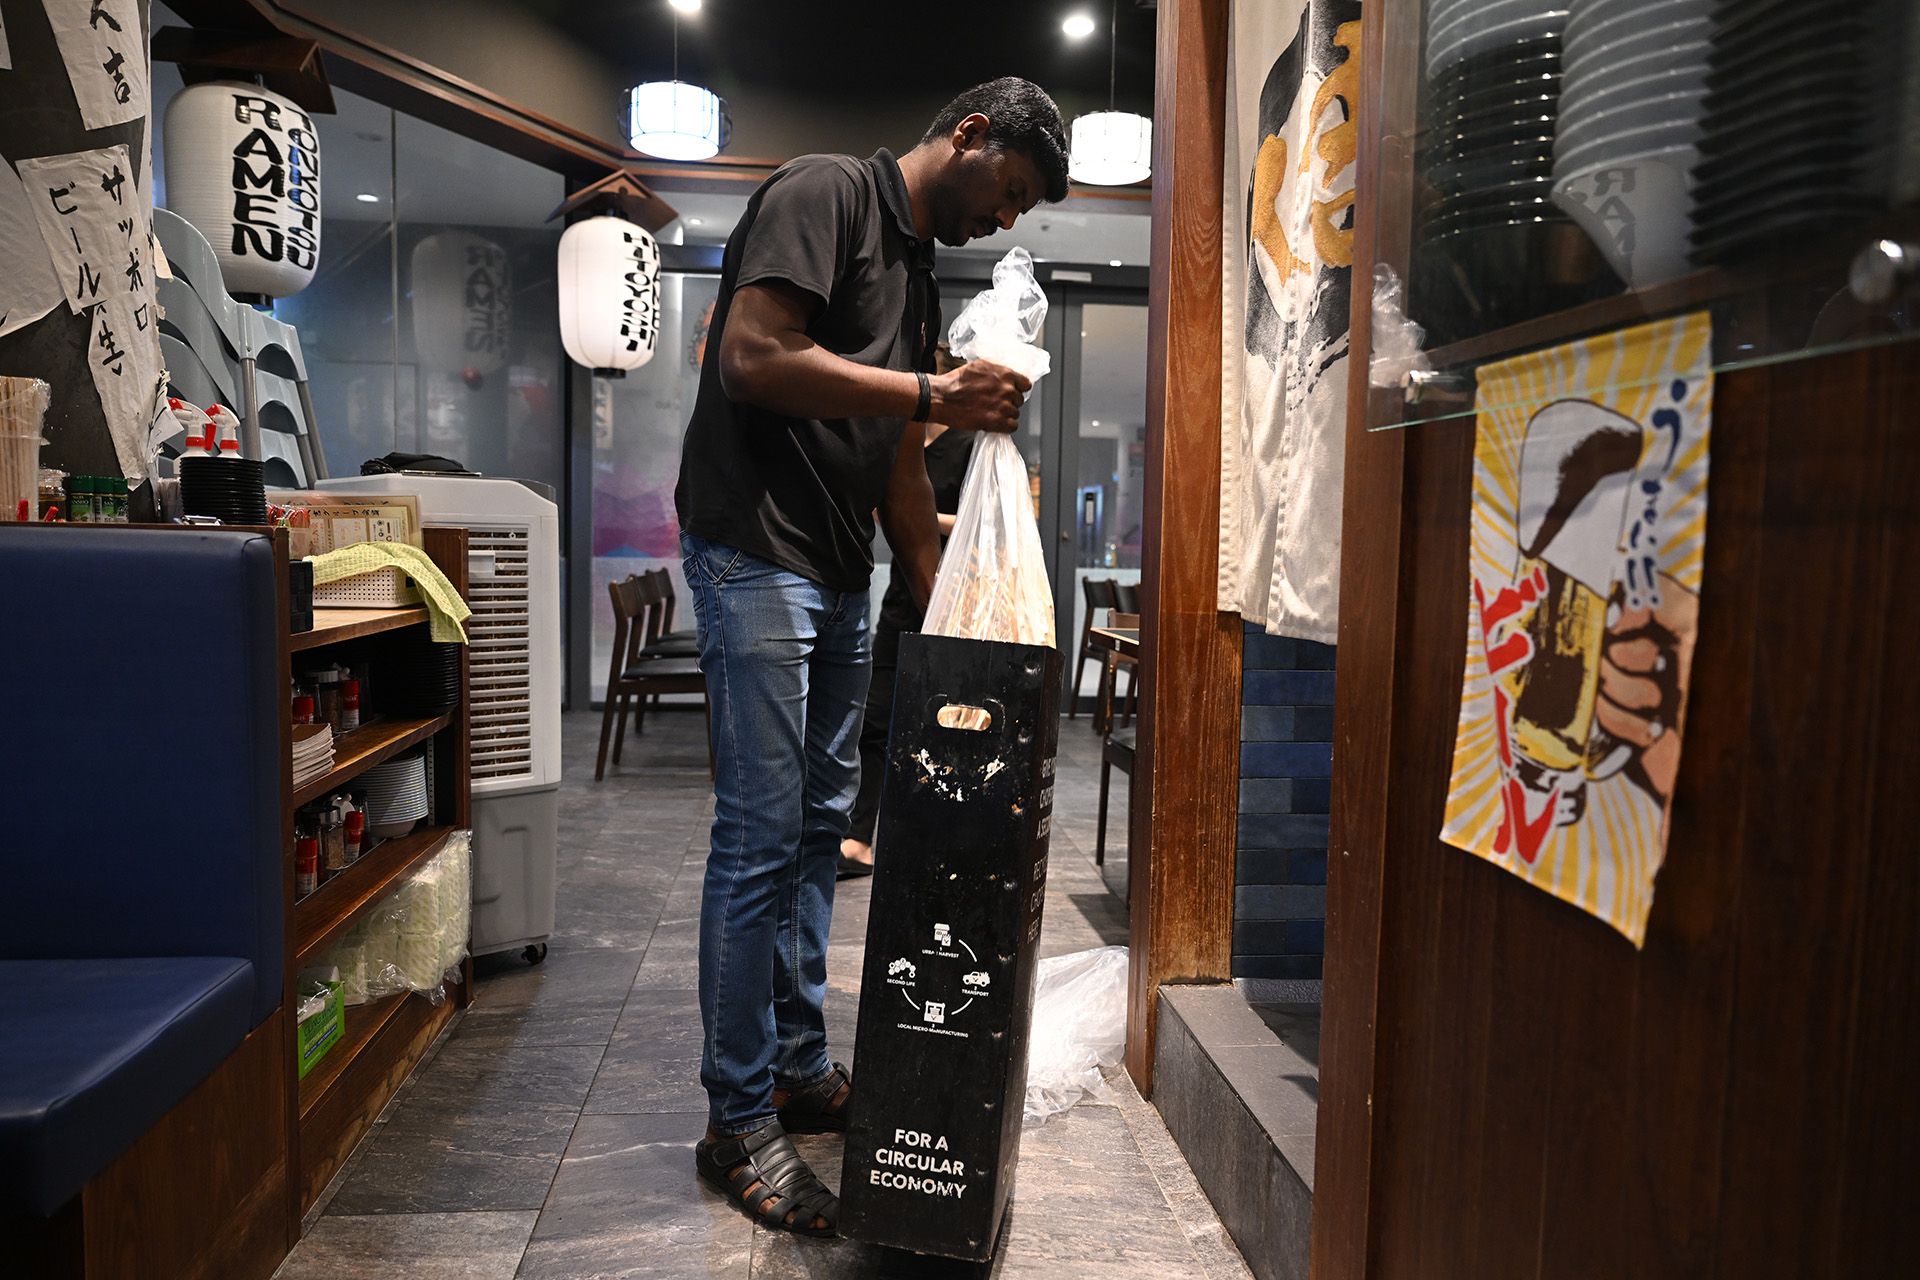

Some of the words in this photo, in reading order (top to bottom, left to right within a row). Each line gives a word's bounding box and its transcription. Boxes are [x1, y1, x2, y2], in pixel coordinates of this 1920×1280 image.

[232, 94, 285, 262] RAMEN
[285, 106, 319, 271] TONKOTSU
[49, 182, 101, 299] ビール
[1475, 567, 1559, 864] ビール
[962, 989, 989, 997] TRANSPORT
[875, 1148, 965, 1176] CIRCULAR
[895, 1129, 932, 1148] FOR
[935, 1136, 949, 1151] A
[870, 1169, 967, 1199] ECONOMY
